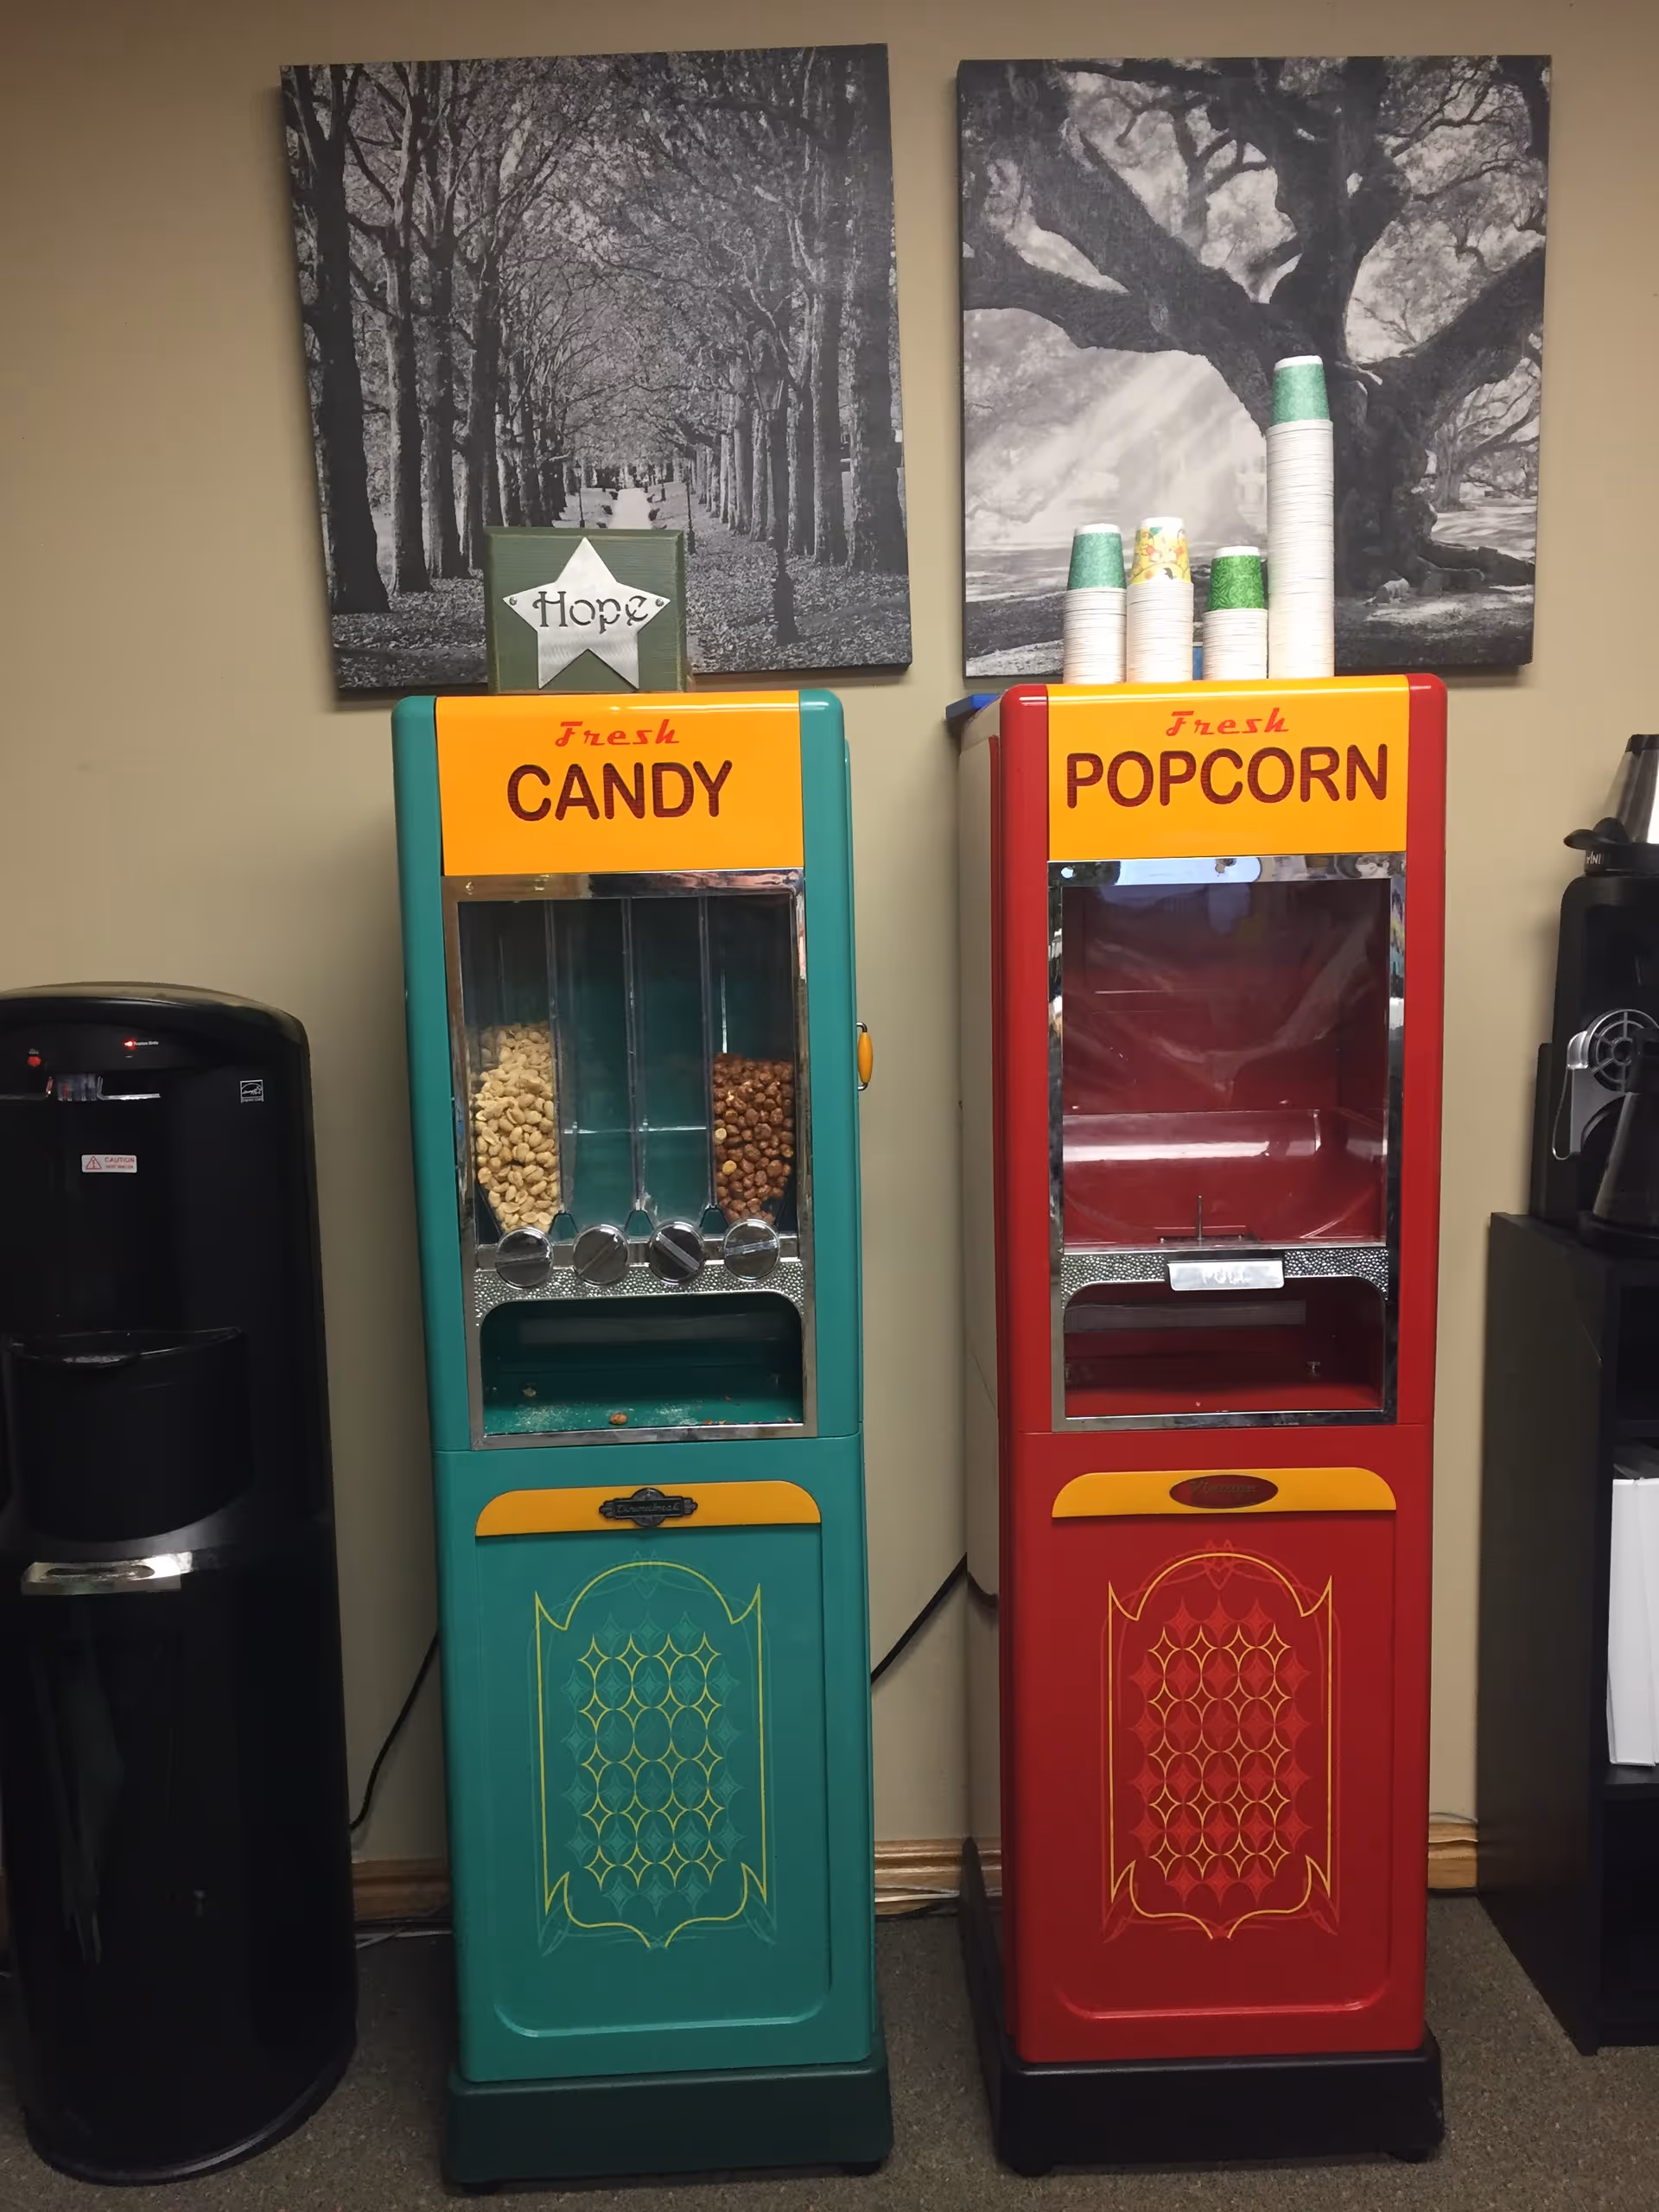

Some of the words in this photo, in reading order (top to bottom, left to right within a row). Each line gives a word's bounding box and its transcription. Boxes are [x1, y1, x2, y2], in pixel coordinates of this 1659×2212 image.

[532, 591, 648, 634] Hope
[555, 719, 680, 747] Fresh
[1166, 707, 1289, 736] Fresh
[507, 760, 733, 821] CANDY
[1066, 743, 1389, 810] POPCORN
